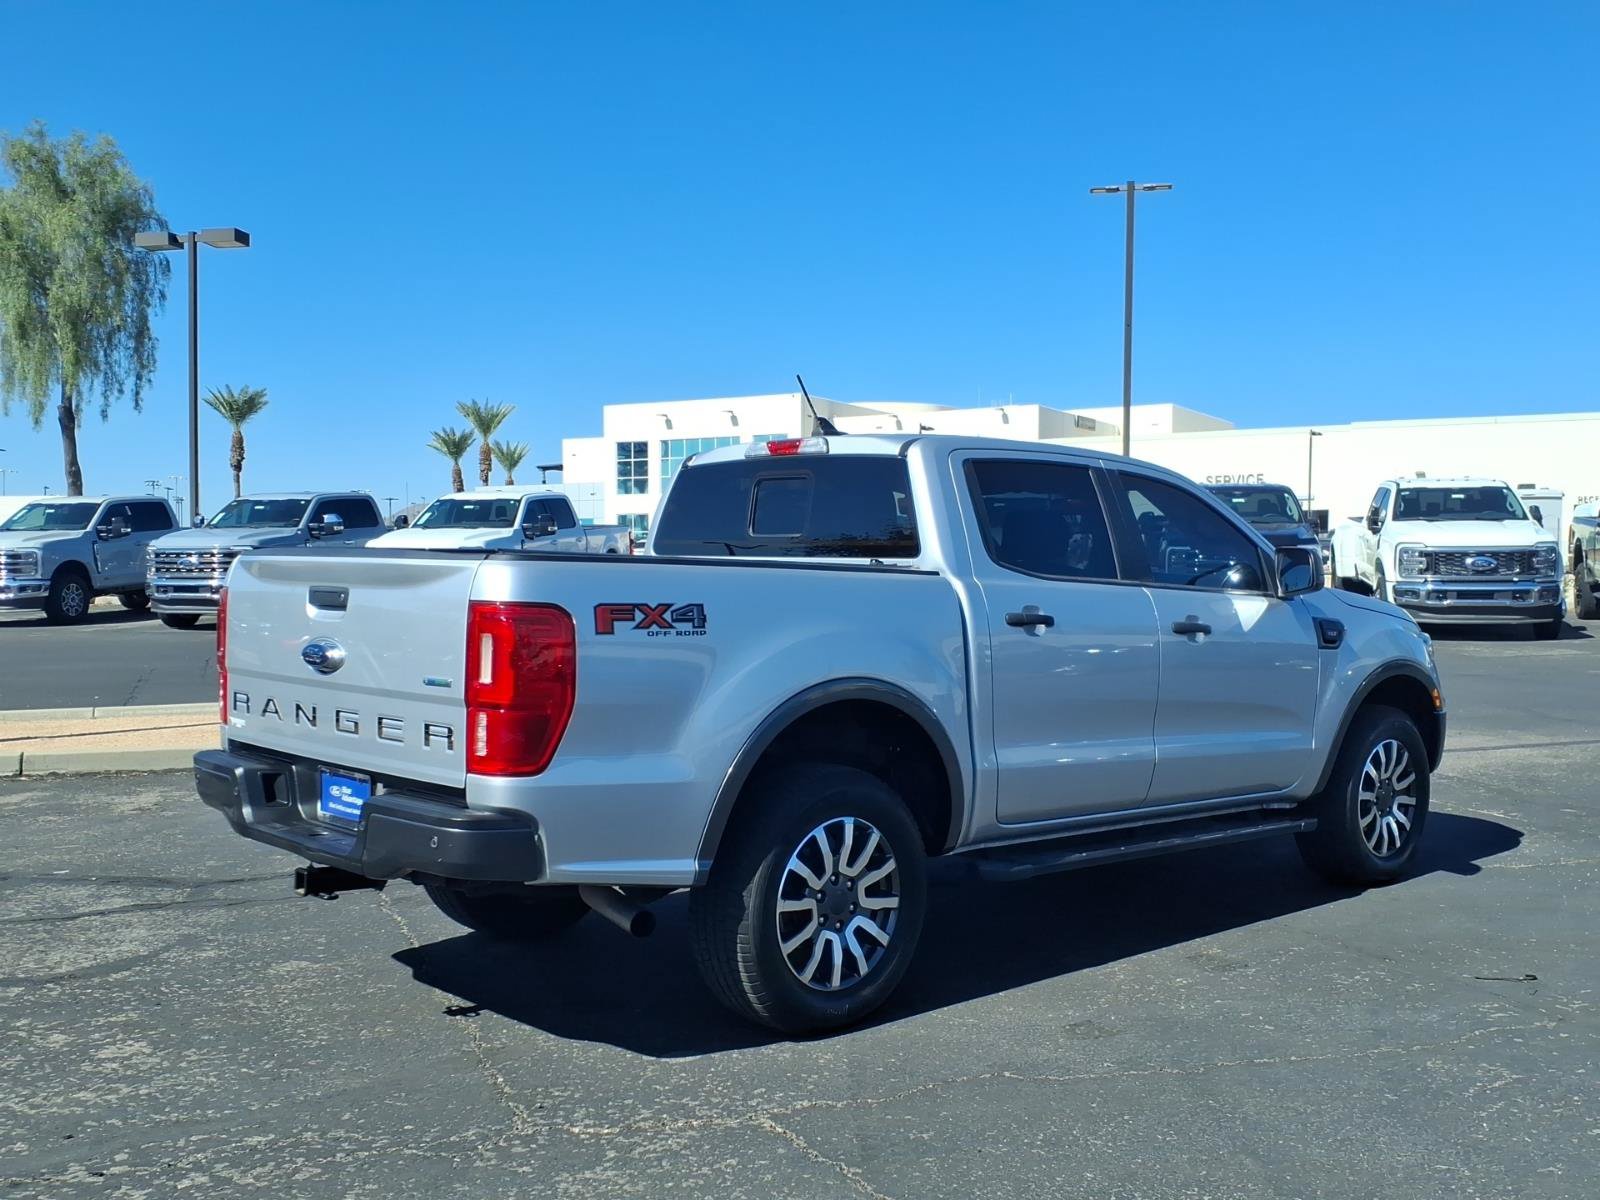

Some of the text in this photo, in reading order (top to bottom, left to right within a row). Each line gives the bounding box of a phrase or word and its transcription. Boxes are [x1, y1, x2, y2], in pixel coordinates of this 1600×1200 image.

[1206, 473, 1265, 484] SERVICE
[593, 602, 707, 636] FX4
[675, 629, 707, 637] ROAD
[232, 690, 455, 752] RANGER
